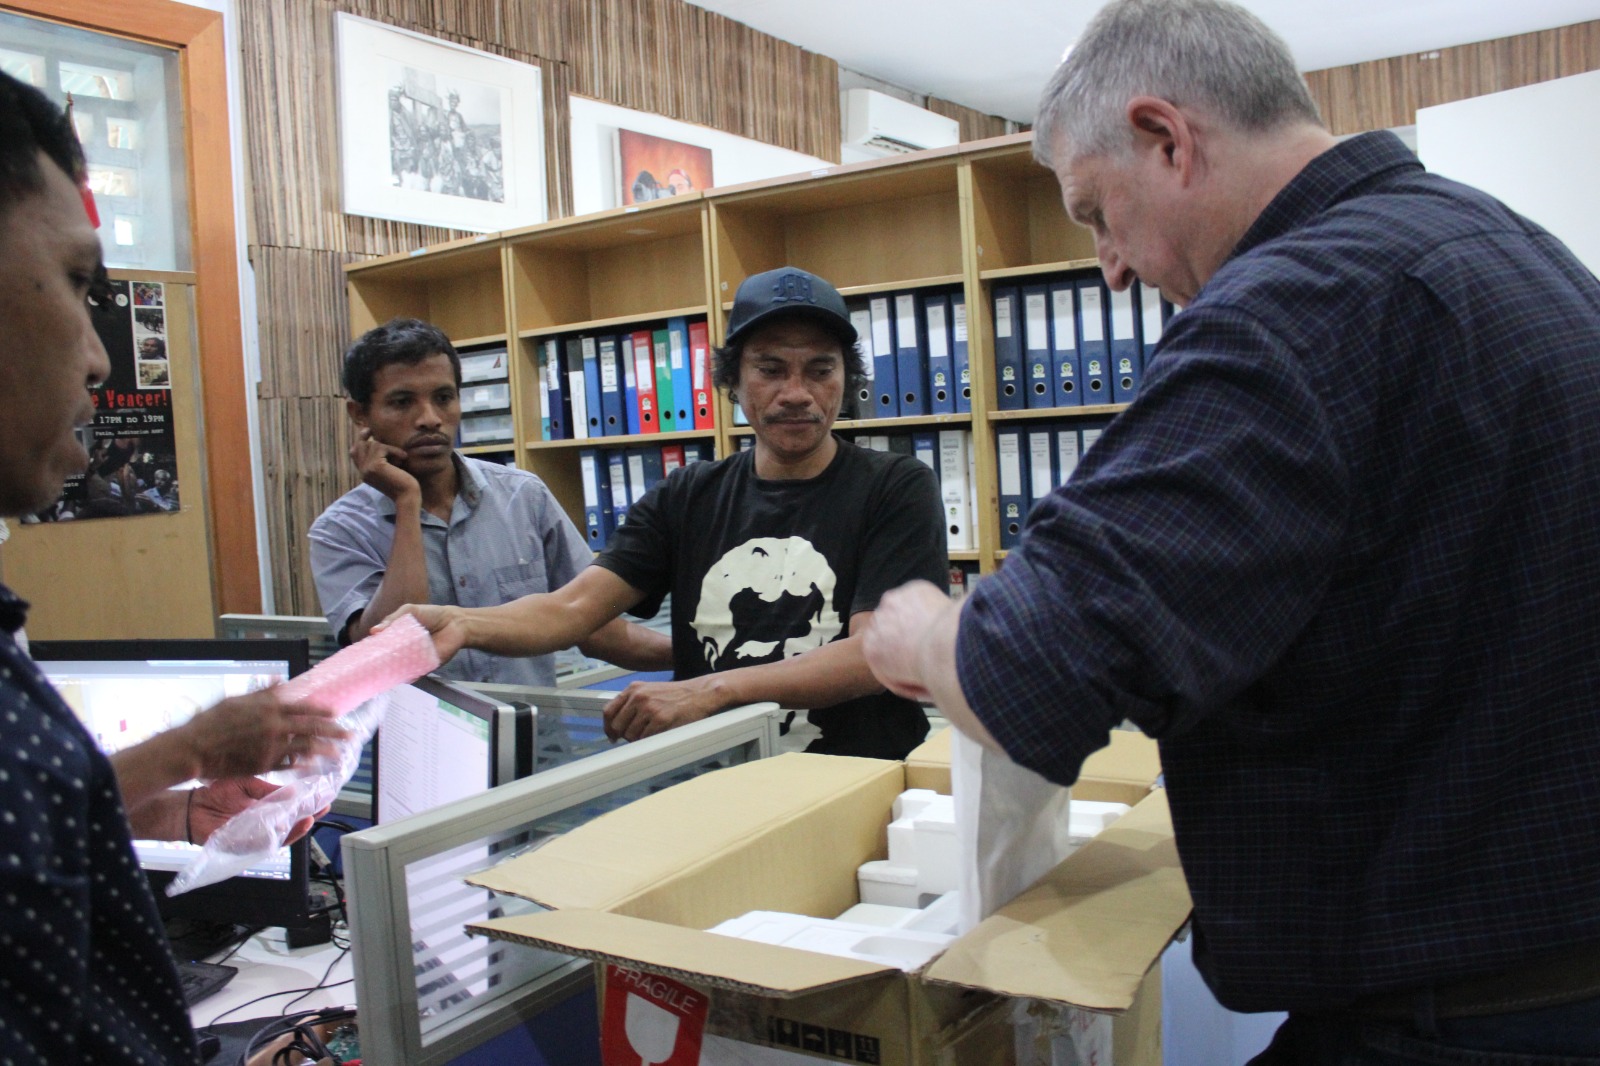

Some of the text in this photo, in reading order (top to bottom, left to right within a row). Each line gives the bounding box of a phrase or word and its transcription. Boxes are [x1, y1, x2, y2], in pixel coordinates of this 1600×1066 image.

[105, 389, 167, 408] Vencer!
[99, 416, 122, 424] 17PM
[142, 415, 165, 423] 19PM
[613, 965, 698, 1015] FRAGILE
